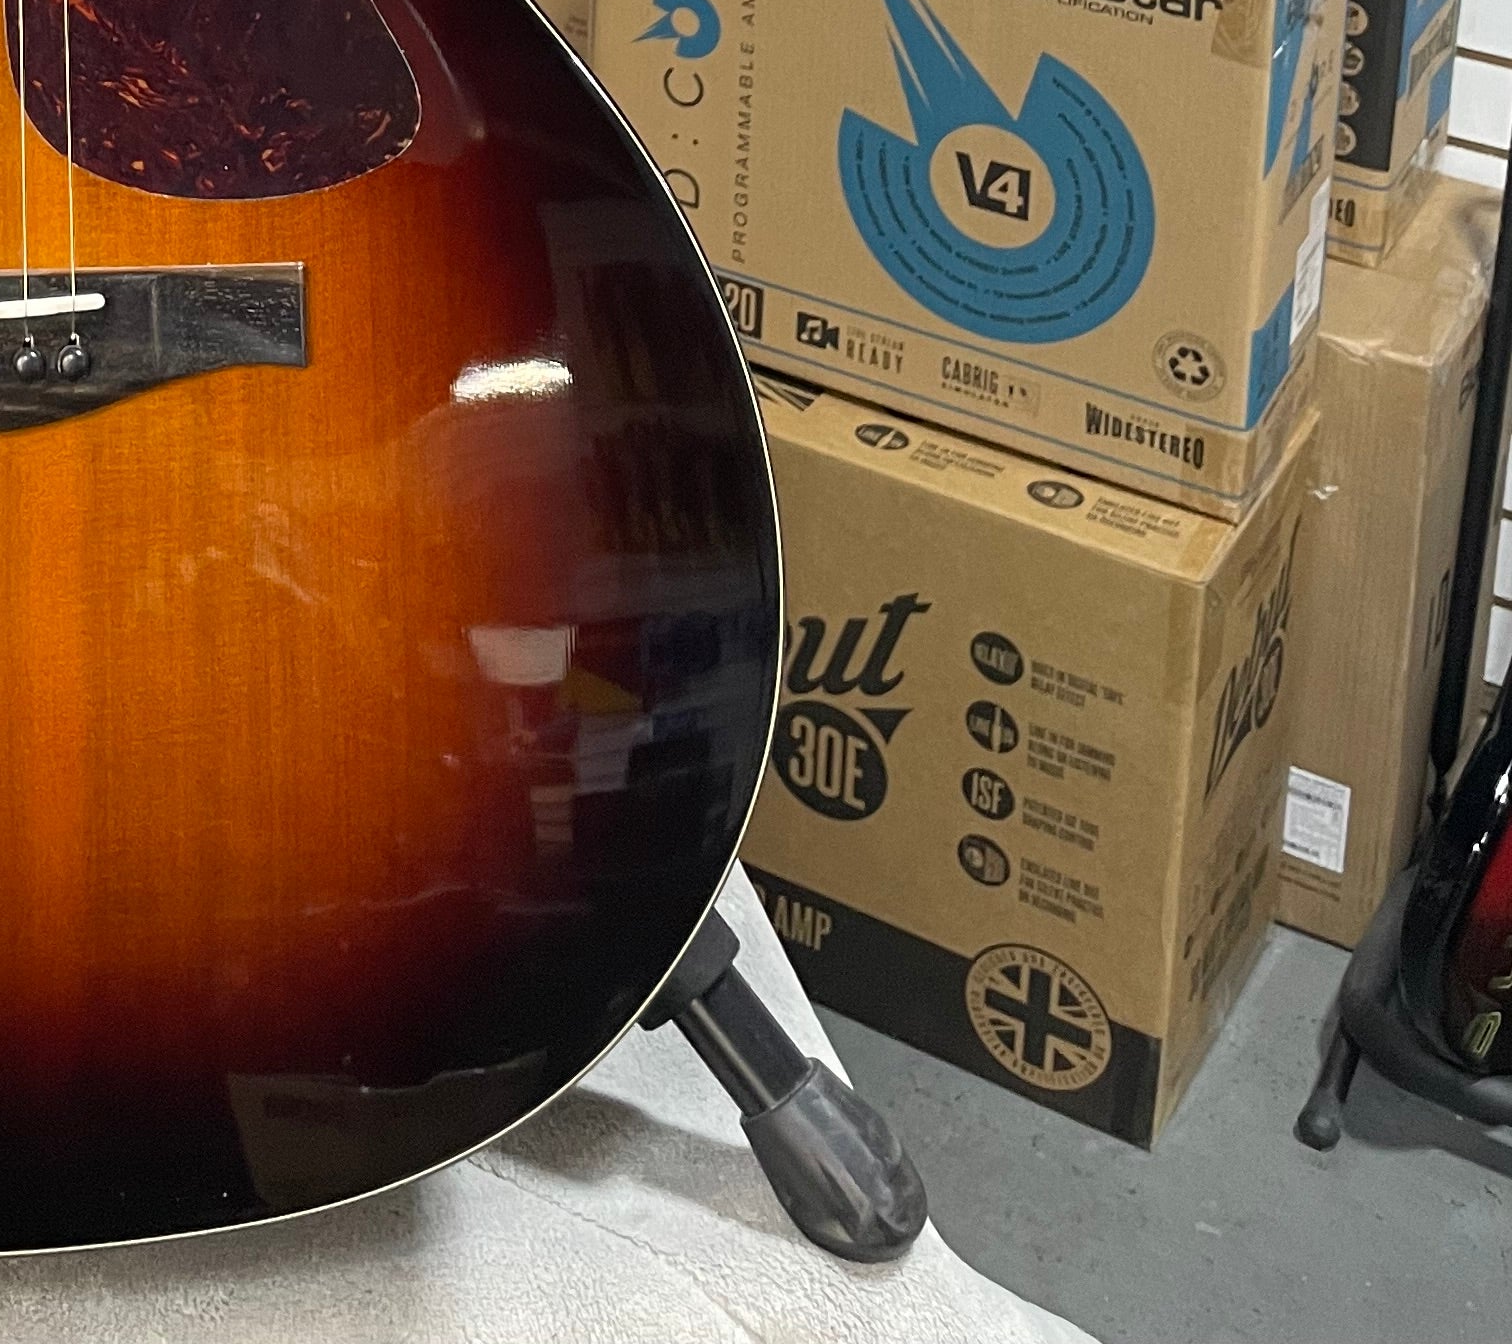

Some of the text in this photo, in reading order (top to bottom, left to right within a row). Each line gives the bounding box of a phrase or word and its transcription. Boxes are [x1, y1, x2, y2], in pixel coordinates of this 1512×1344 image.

[731, 41, 756, 264] PROGRAMMABLE
[955, 150, 1031, 222] V4
[846, 339, 905, 375] READY
[1085, 401, 1206, 470] WIDESTEREO
[789, 713, 870, 811] 30E
[971, 771, 1006, 814] ISF
[773, 895, 833, 952] AMP
